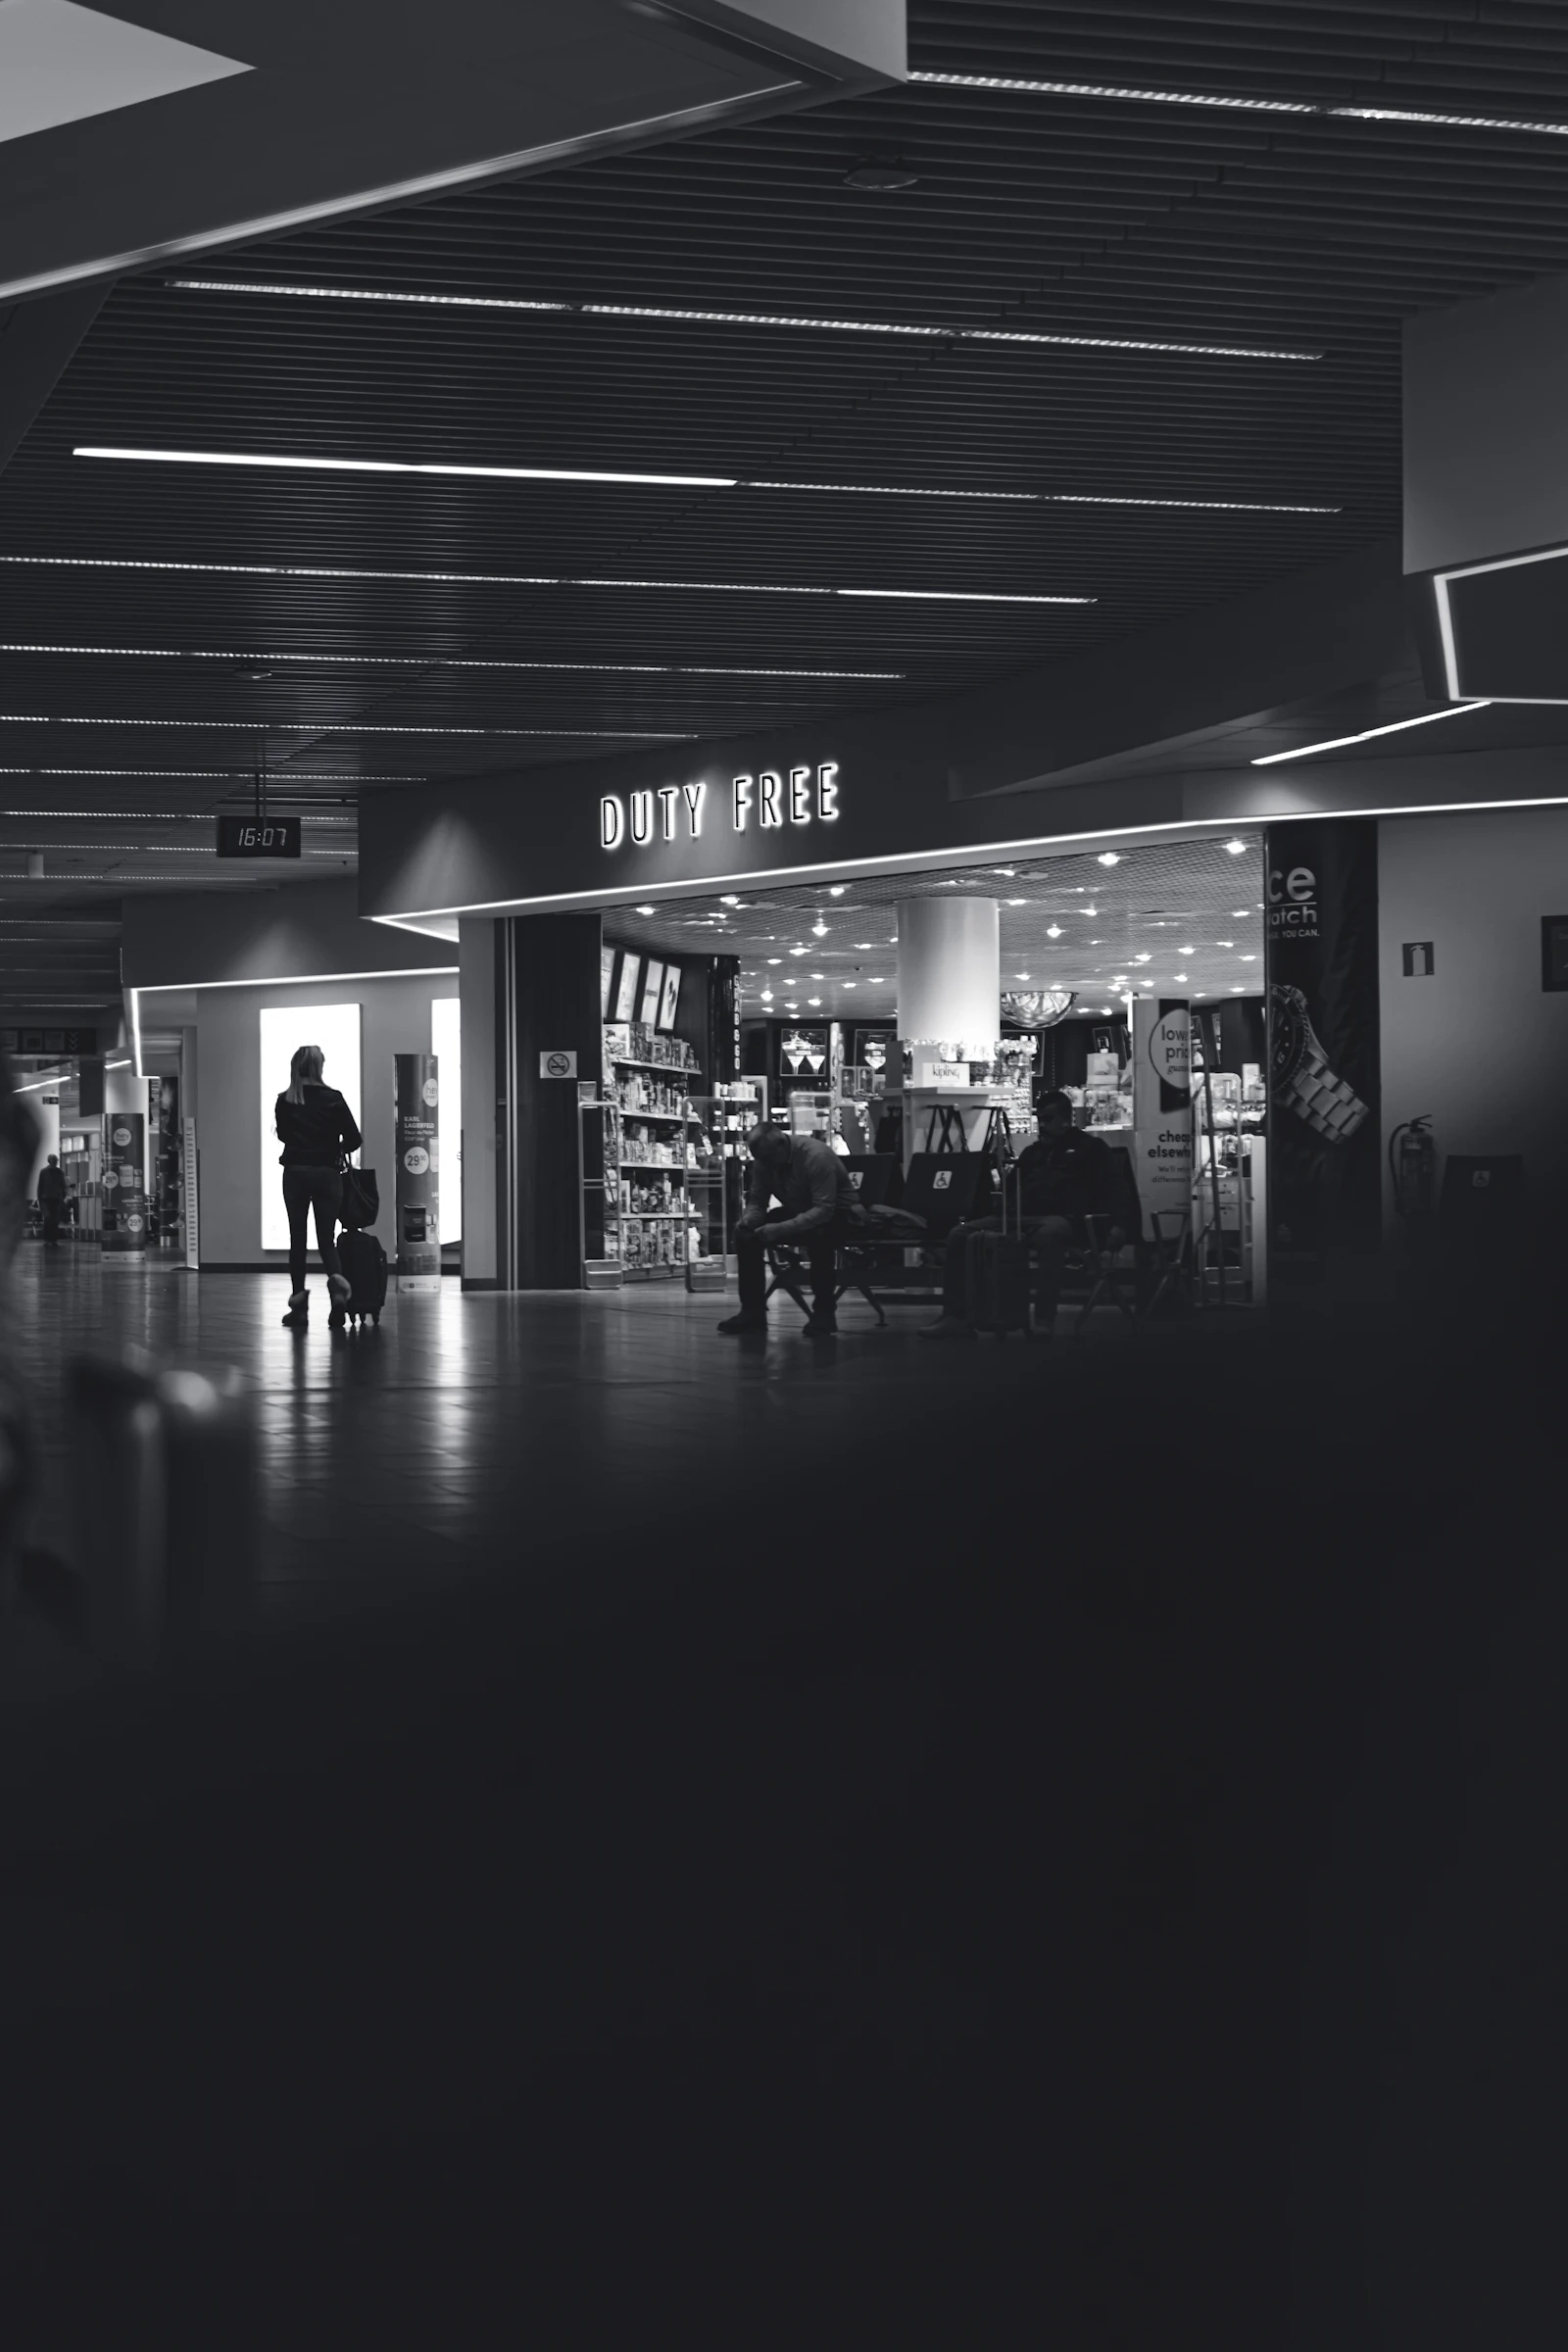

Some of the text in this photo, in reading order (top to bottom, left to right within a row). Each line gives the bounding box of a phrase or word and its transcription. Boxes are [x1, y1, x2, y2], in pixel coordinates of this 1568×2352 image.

[601, 763, 839, 849] DUTY FREE
[238, 828, 287, 847] 16:07
[1298, 929, 1320, 938] CAN.
[733, 1044, 741, 1070] GO
